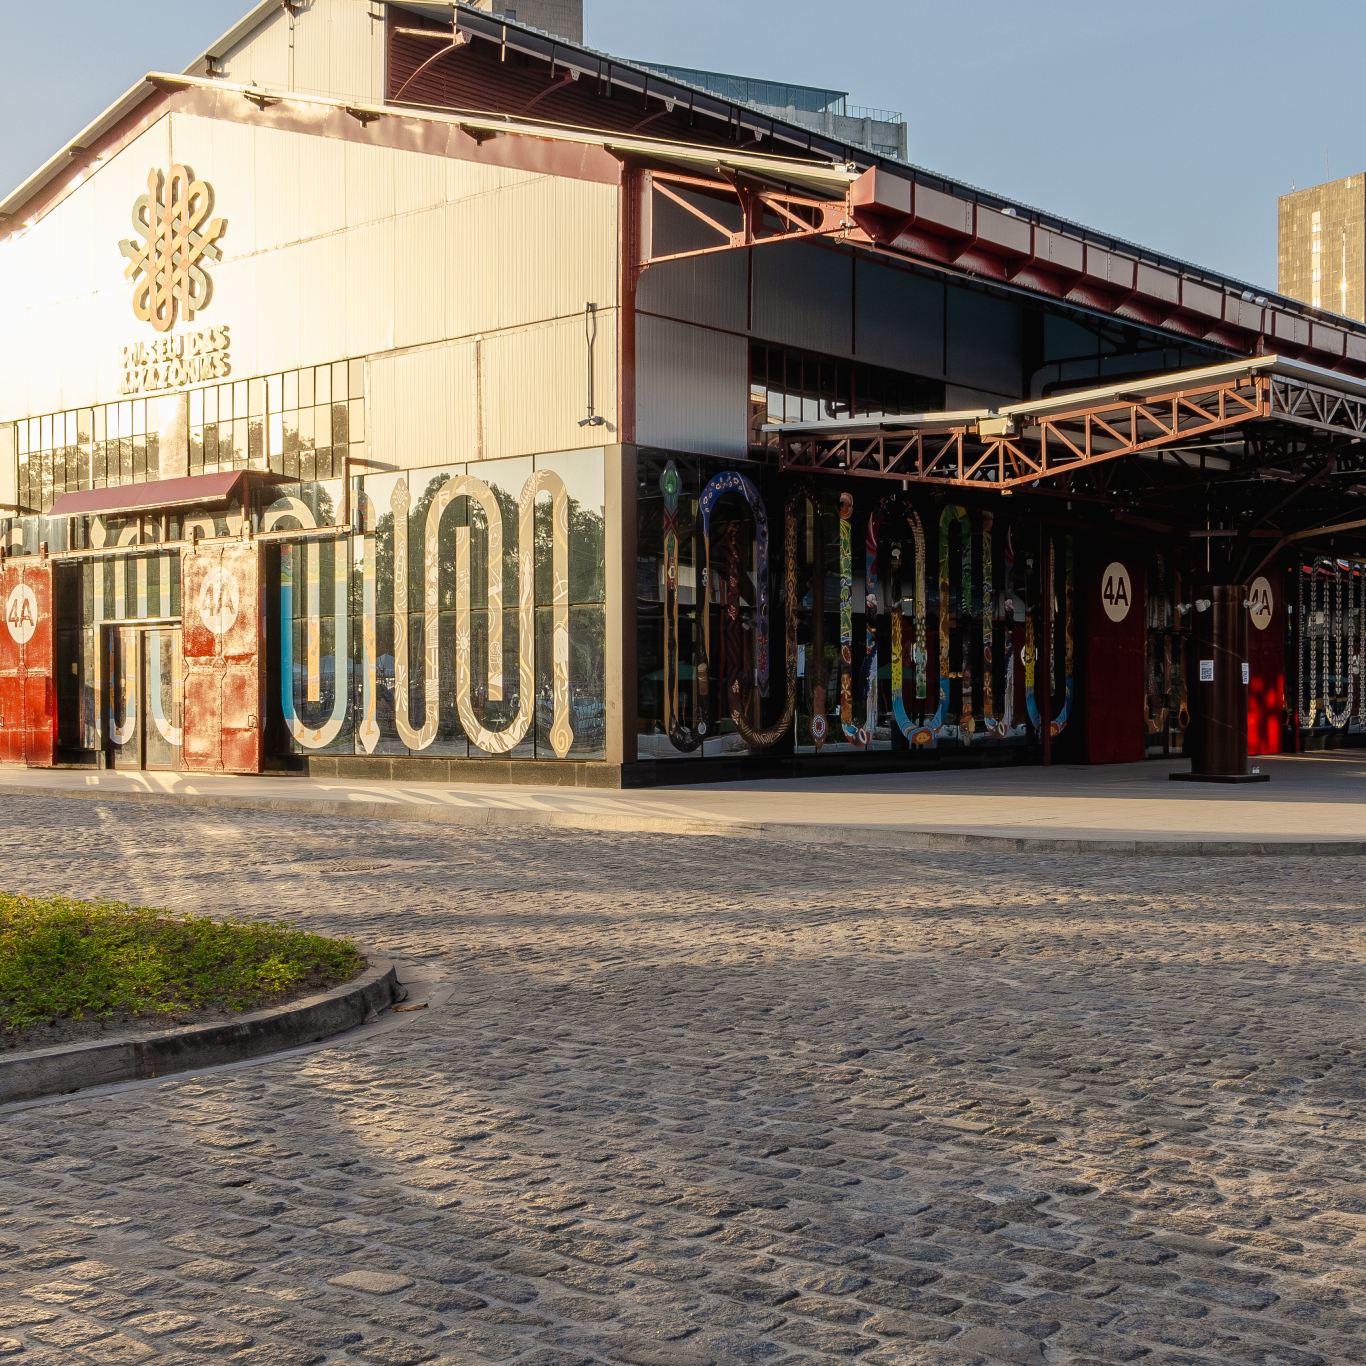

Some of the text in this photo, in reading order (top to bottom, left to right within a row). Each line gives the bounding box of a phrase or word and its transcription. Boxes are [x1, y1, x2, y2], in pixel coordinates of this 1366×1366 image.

[118, 325, 231, 369] MUSEU DAS
[202, 584, 236, 616] 4A
[1103, 575, 1129, 606] 4A
[8, 598, 35, 628] 4A
